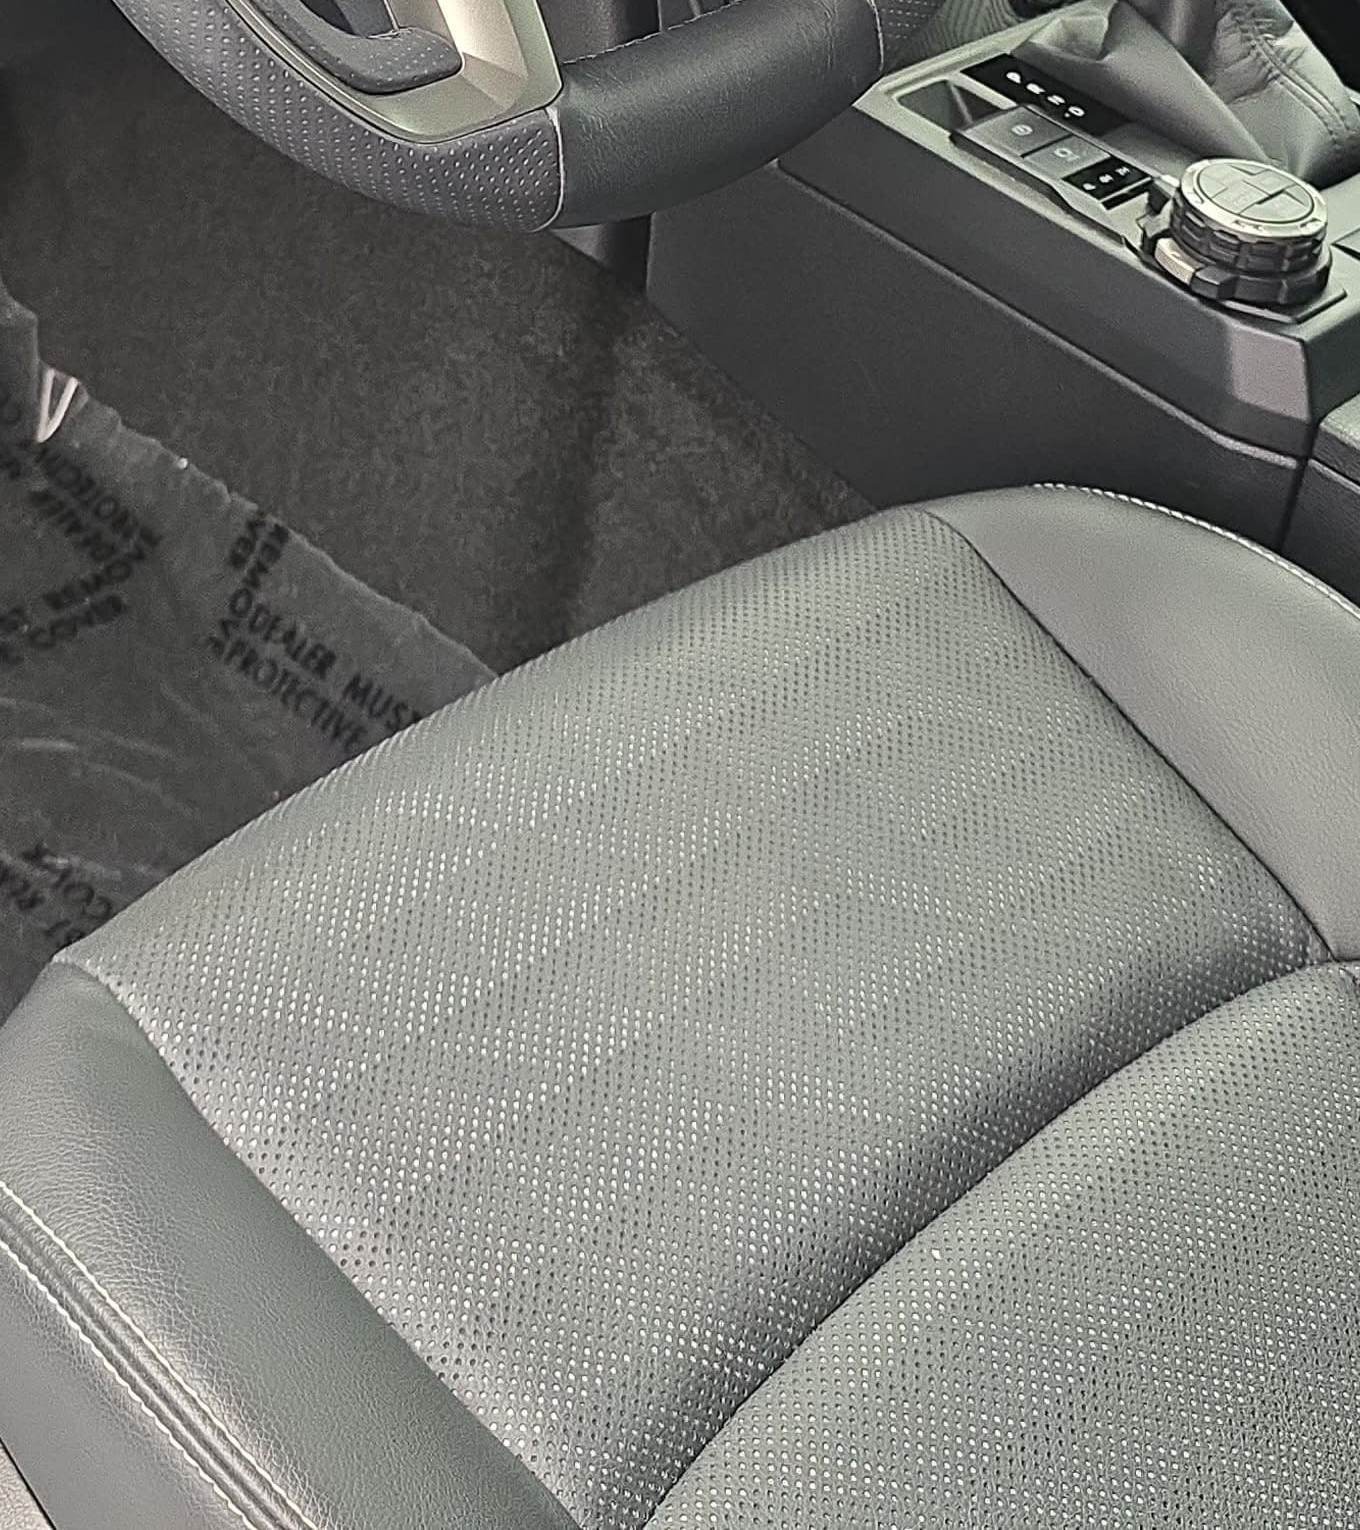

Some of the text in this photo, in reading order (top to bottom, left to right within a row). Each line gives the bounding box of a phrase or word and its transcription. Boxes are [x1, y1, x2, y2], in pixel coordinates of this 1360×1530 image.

[26, 592, 125, 650] COVER
[248, 602, 338, 682] DEALER
[223, 637, 369, 754] PROTECTIVE
